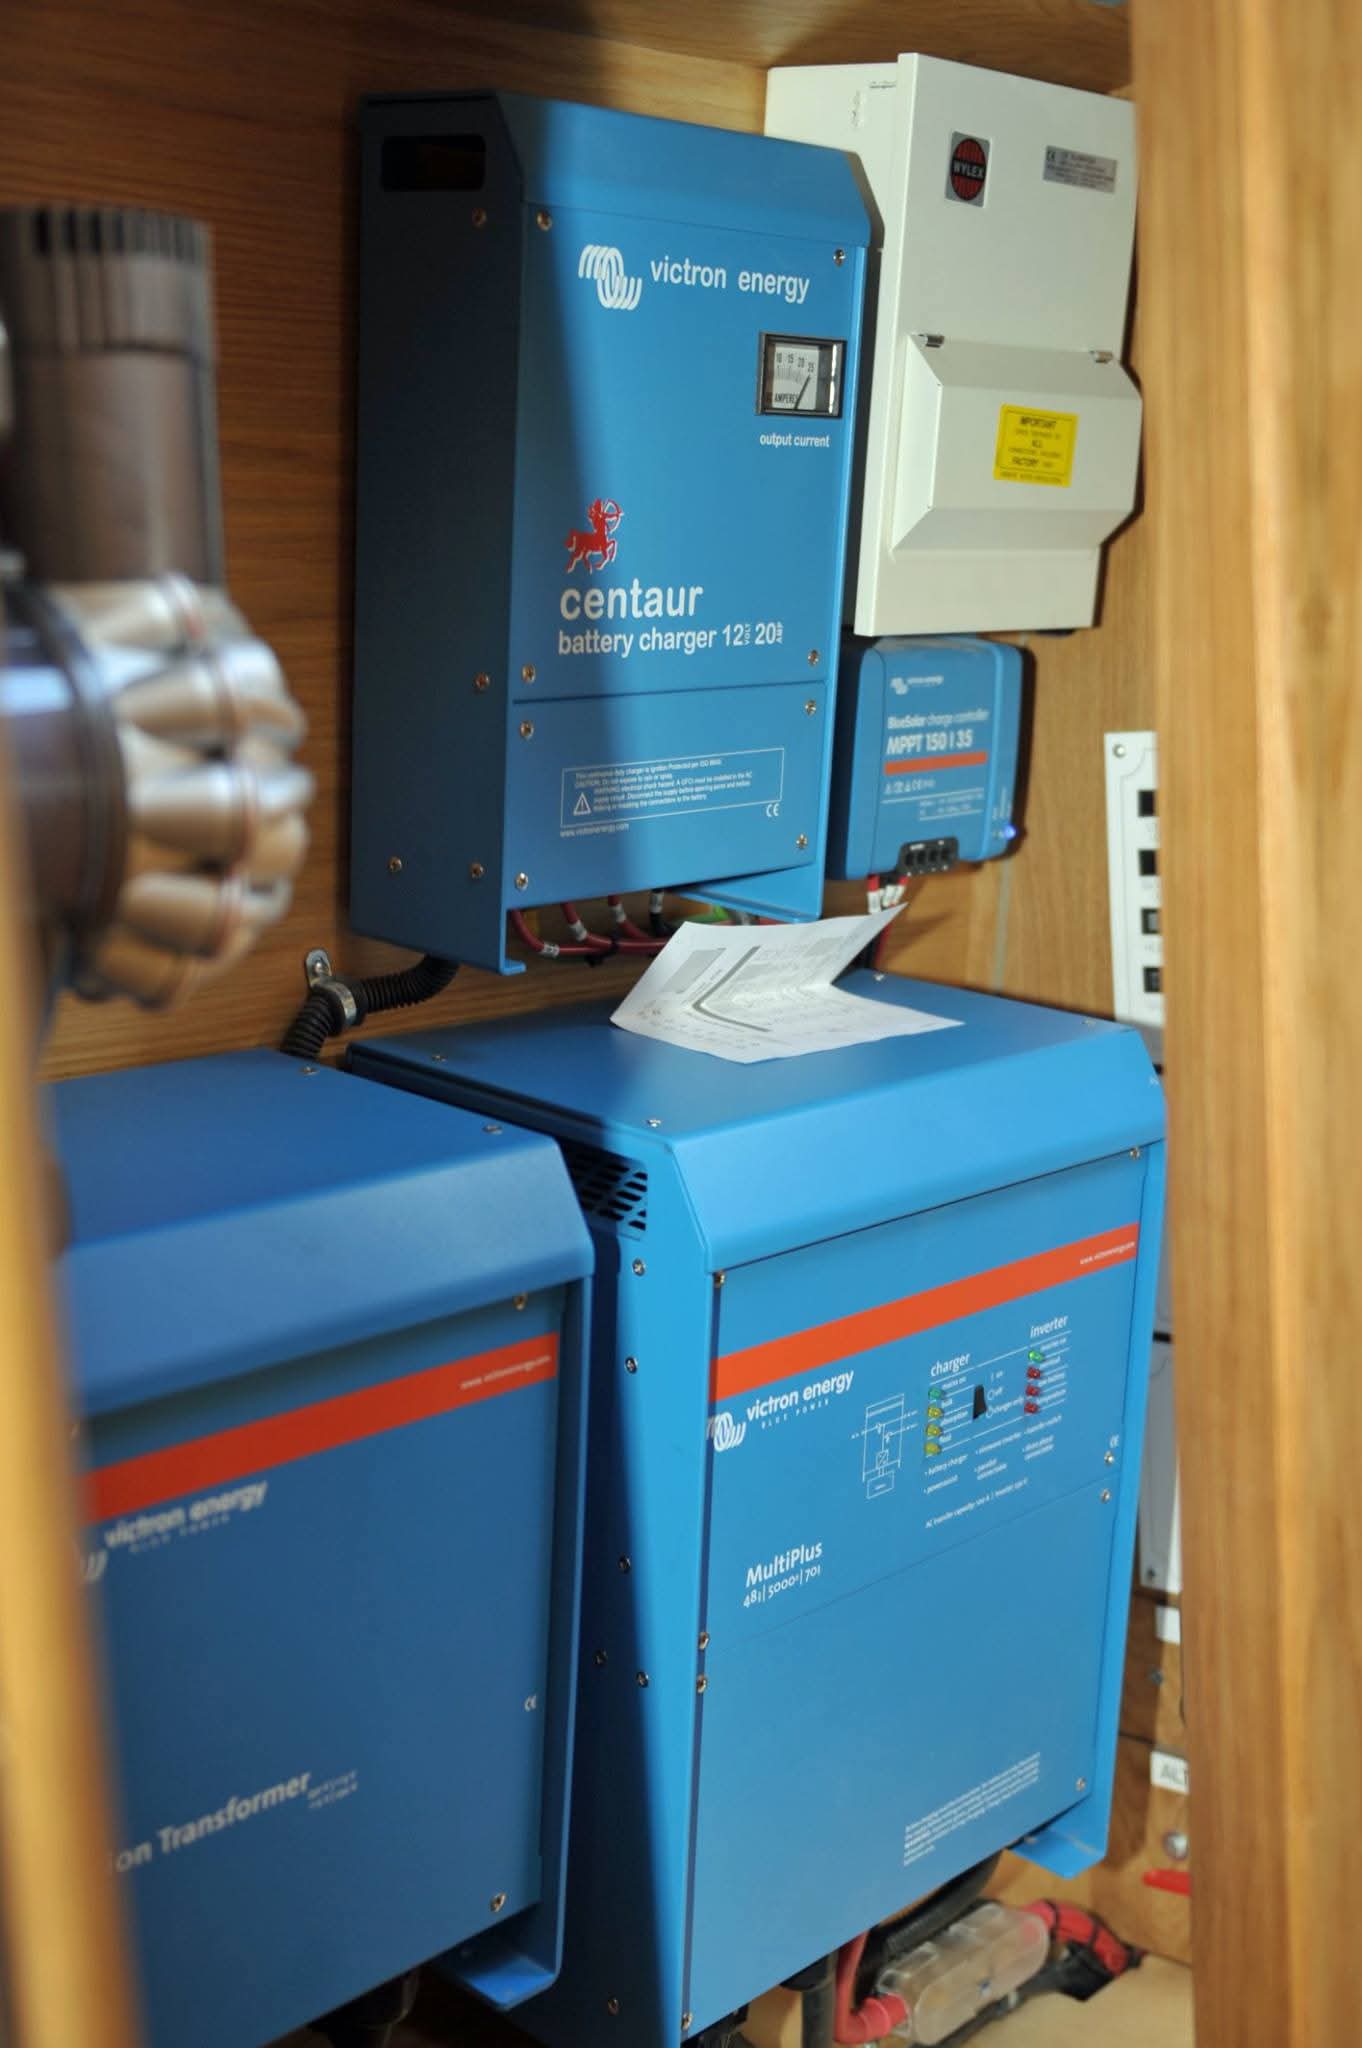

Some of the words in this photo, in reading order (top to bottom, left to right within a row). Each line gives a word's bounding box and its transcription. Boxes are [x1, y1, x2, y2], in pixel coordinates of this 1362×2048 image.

[651, 255, 727, 289] victron
[738, 270, 811, 304] energy
[760, 433, 792, 448] output
[793, 434, 830, 448] current
[560, 578, 704, 620] centaur
[558, 629, 634, 658] battery
[639, 626, 717, 656] charger
[723, 624, 744, 647] 12
[755, 622, 776, 646] 20
[885, 733, 923, 755] MPPT
[925, 732, 948, 751] 150
[956, 729, 974, 748] 35
[1030, 1315, 1068, 1338] inverter
[930, 1353, 970, 1377] charger
[746, 1391, 799, 1422] victron
[802, 1370, 854, 1401] energy
[104, 1507, 186, 1548] victron
[189, 1479, 269, 1522] energy
[746, 1542, 822, 1588] MultiPlus
[114, 1841, 152, 1873] on
[157, 1771, 311, 1854] Transformer
